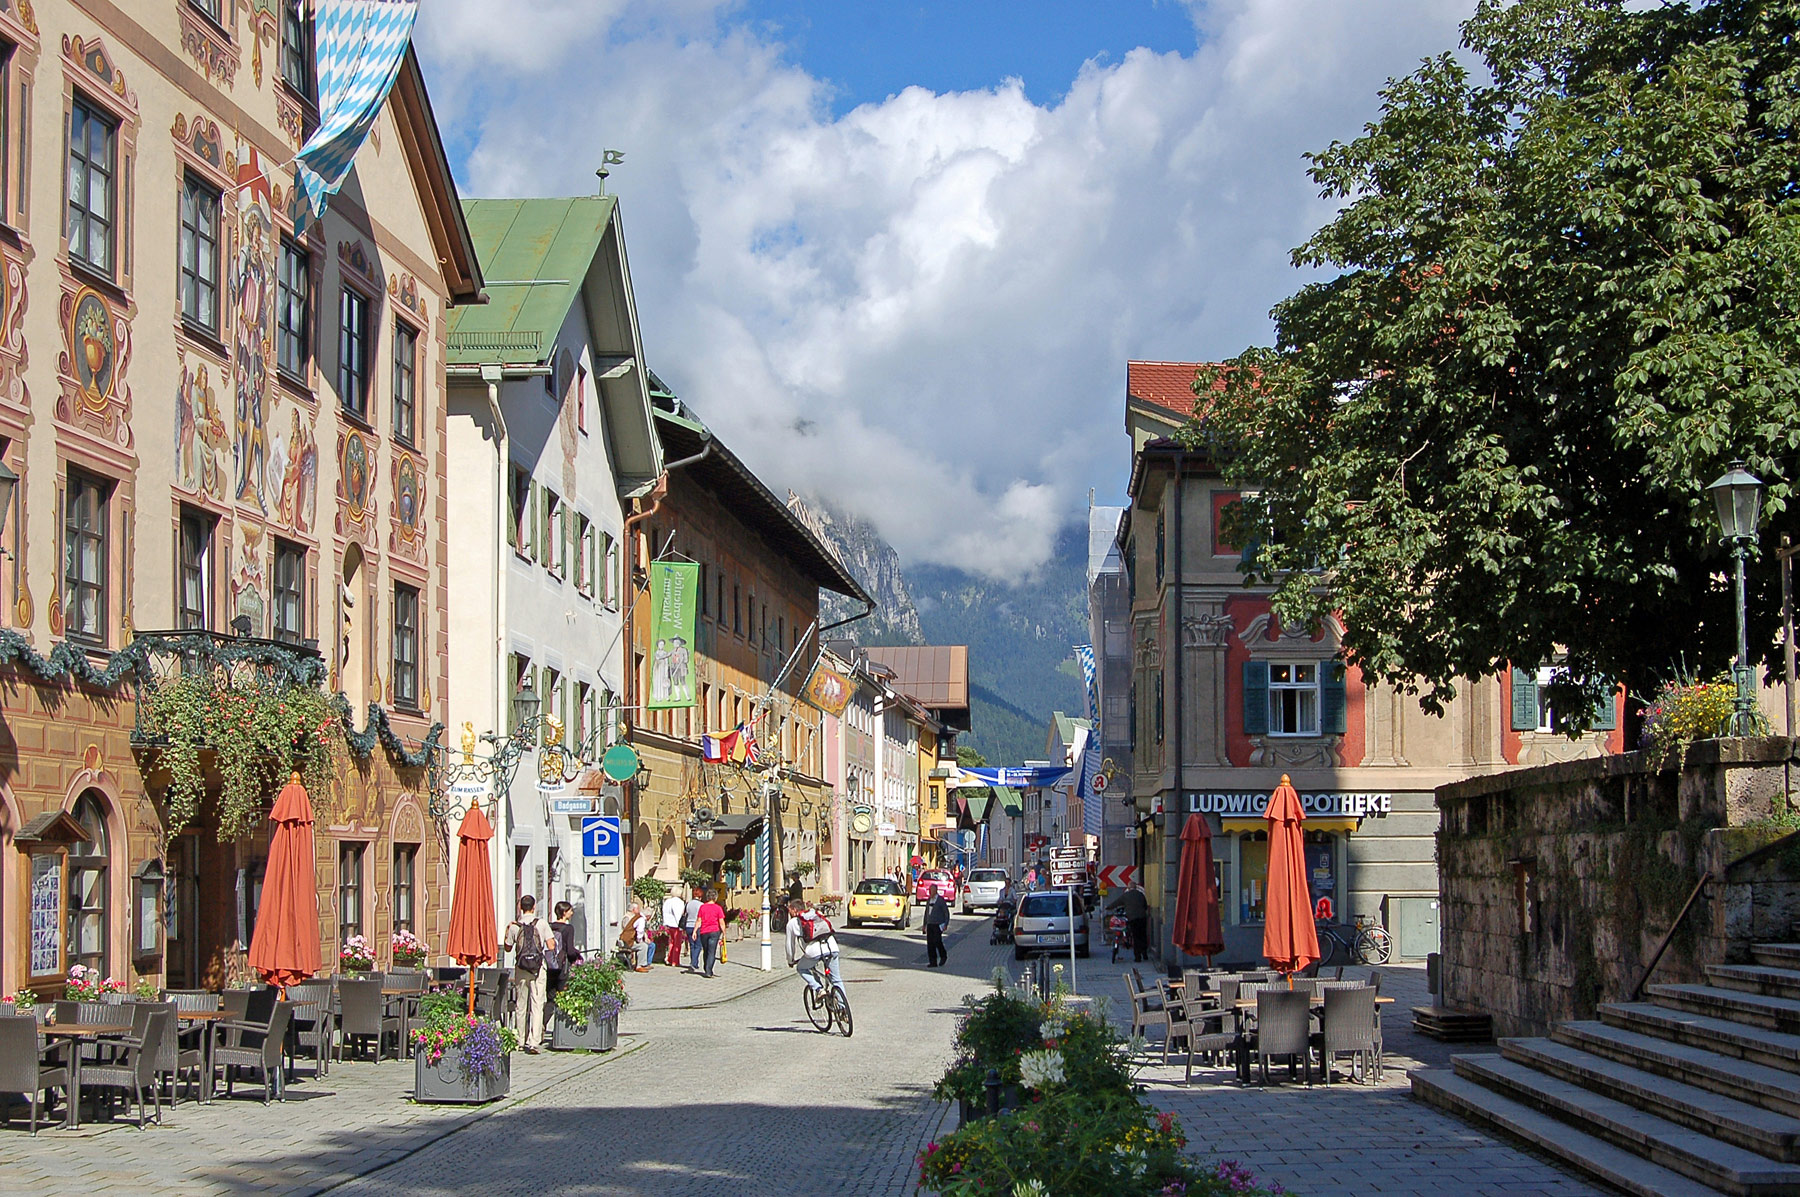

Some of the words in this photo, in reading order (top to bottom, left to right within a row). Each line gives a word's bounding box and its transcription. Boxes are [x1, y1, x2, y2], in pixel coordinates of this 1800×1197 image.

[557, 800, 587, 812] Badgasse
[1189, 794, 1275, 813] LUDWIG
[1301, 794, 1392, 813] POTHEKE
[593, 829, 611, 855] P
